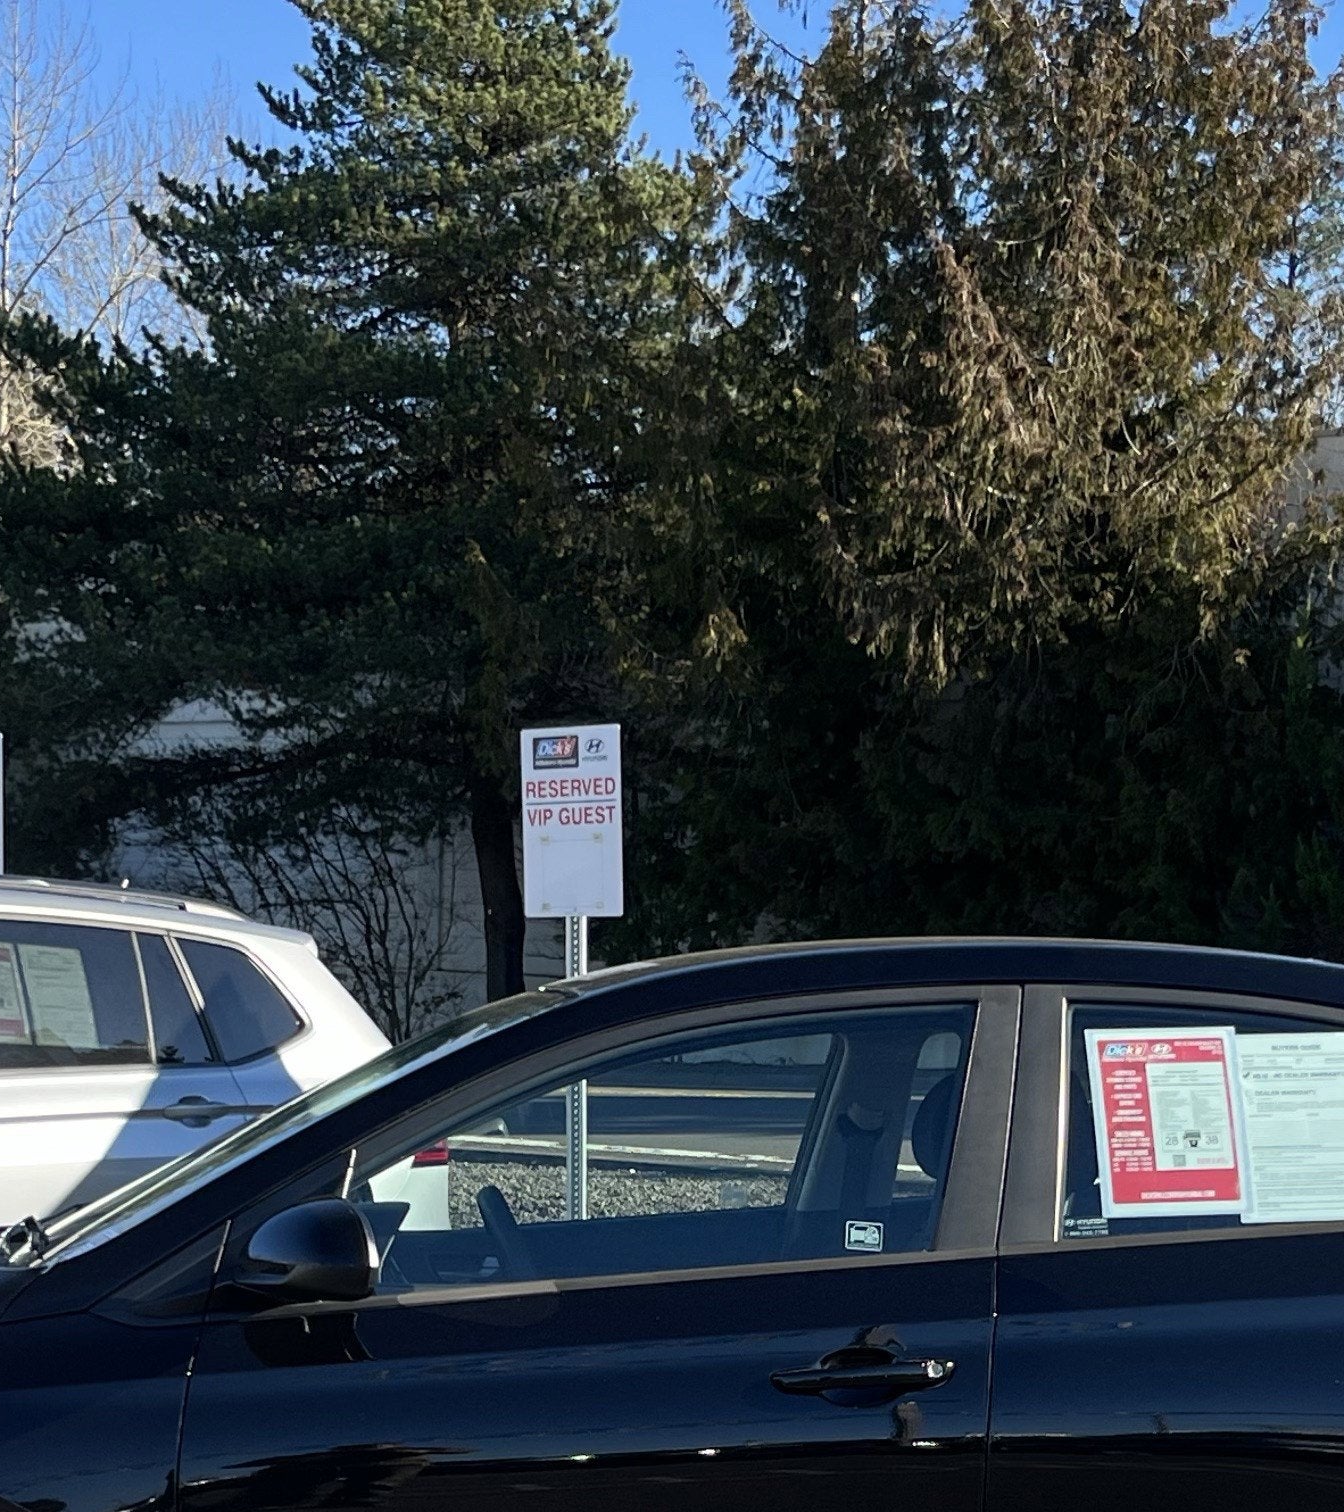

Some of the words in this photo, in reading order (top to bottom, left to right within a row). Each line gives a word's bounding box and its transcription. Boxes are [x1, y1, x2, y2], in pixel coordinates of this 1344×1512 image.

[525, 777, 616, 798] RESERVED
[527, 808, 554, 826] VIP
[558, 805, 616, 826] GUEST
